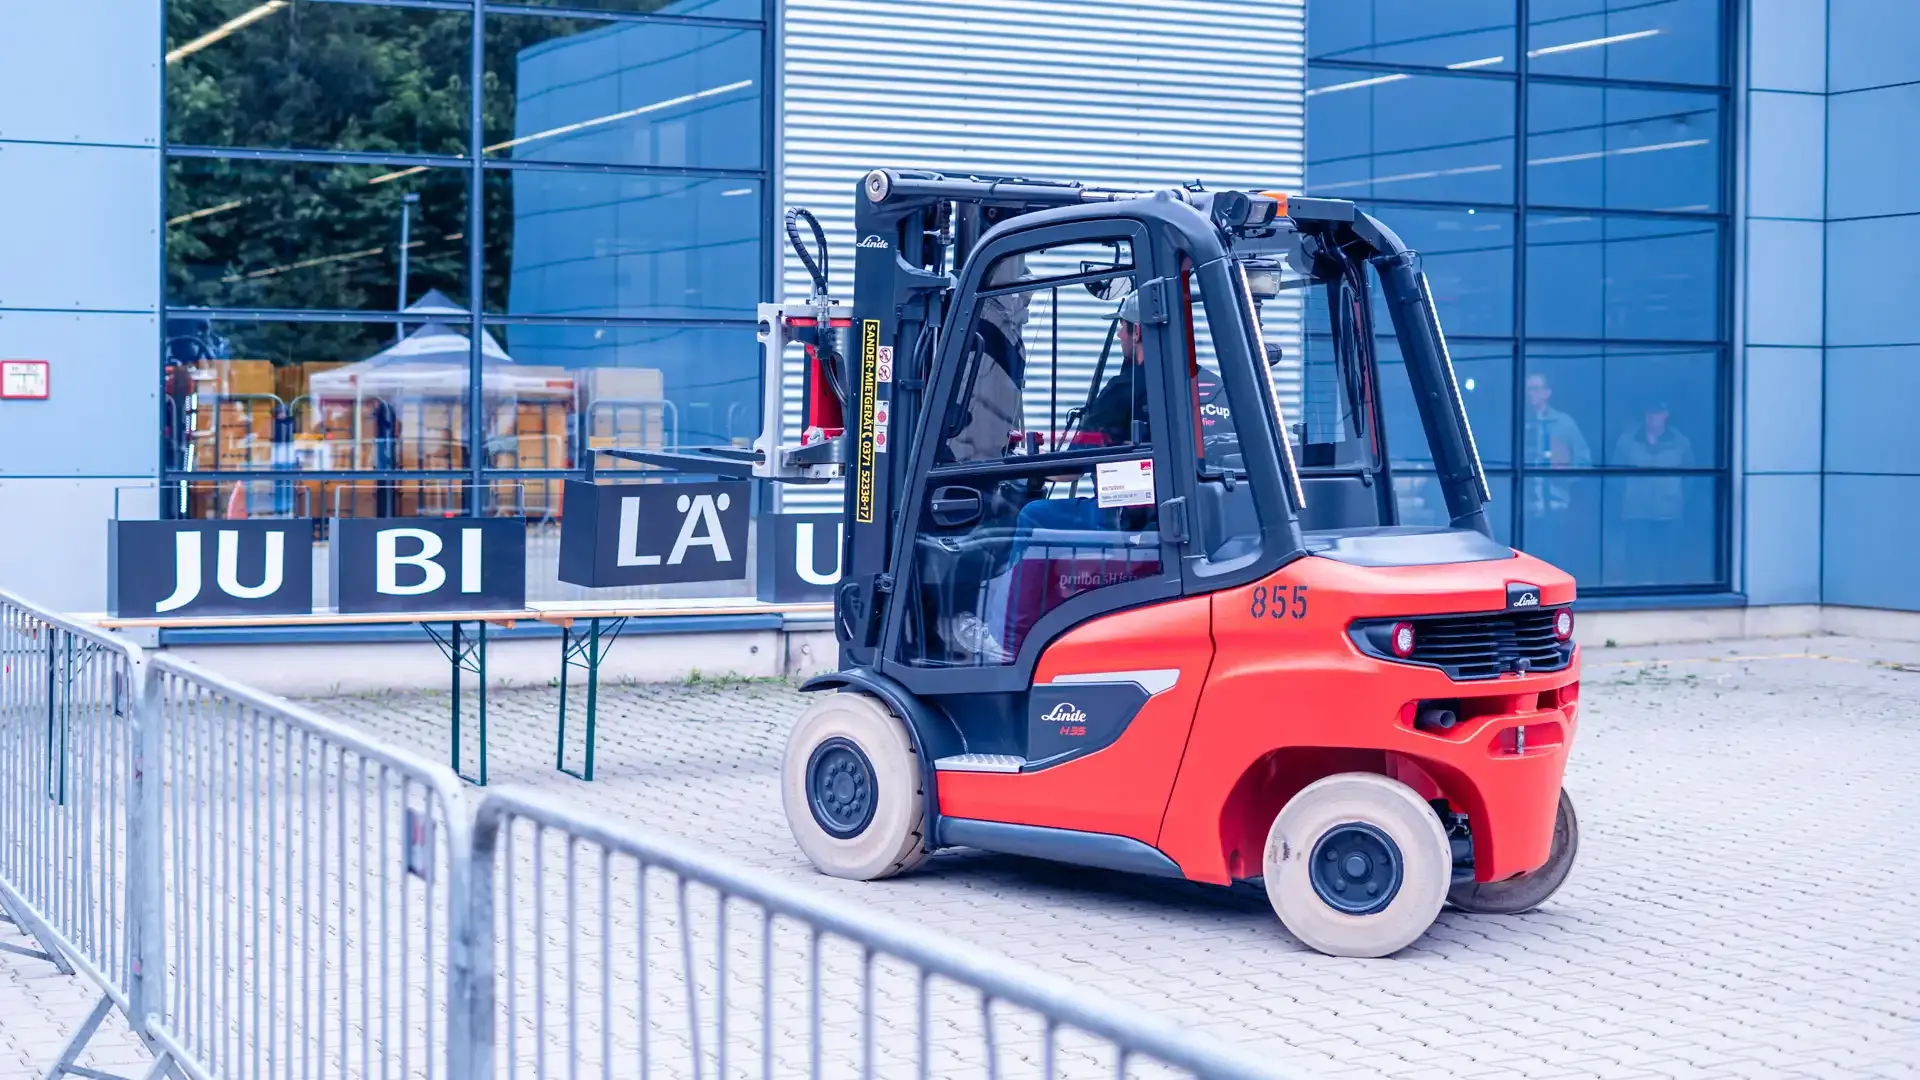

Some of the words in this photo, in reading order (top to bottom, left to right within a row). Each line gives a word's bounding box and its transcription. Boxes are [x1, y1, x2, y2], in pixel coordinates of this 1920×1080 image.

[856, 234, 889, 249] Linde
[863, 323, 876, 431] SANDER-MIETGERÄT
[1200, 403, 1230, 420] rCup
[862, 441, 872, 466] 0371
[860, 469, 871, 519] 52338-17
[155, 529, 285, 613] JU
[376, 527, 482, 596] BI
[616, 492, 733, 567] LÄ
[1250, 585, 1308, 620] 855
[1513, 592, 1539, 607] Linde
[1041, 702, 1087, 722] Linde
